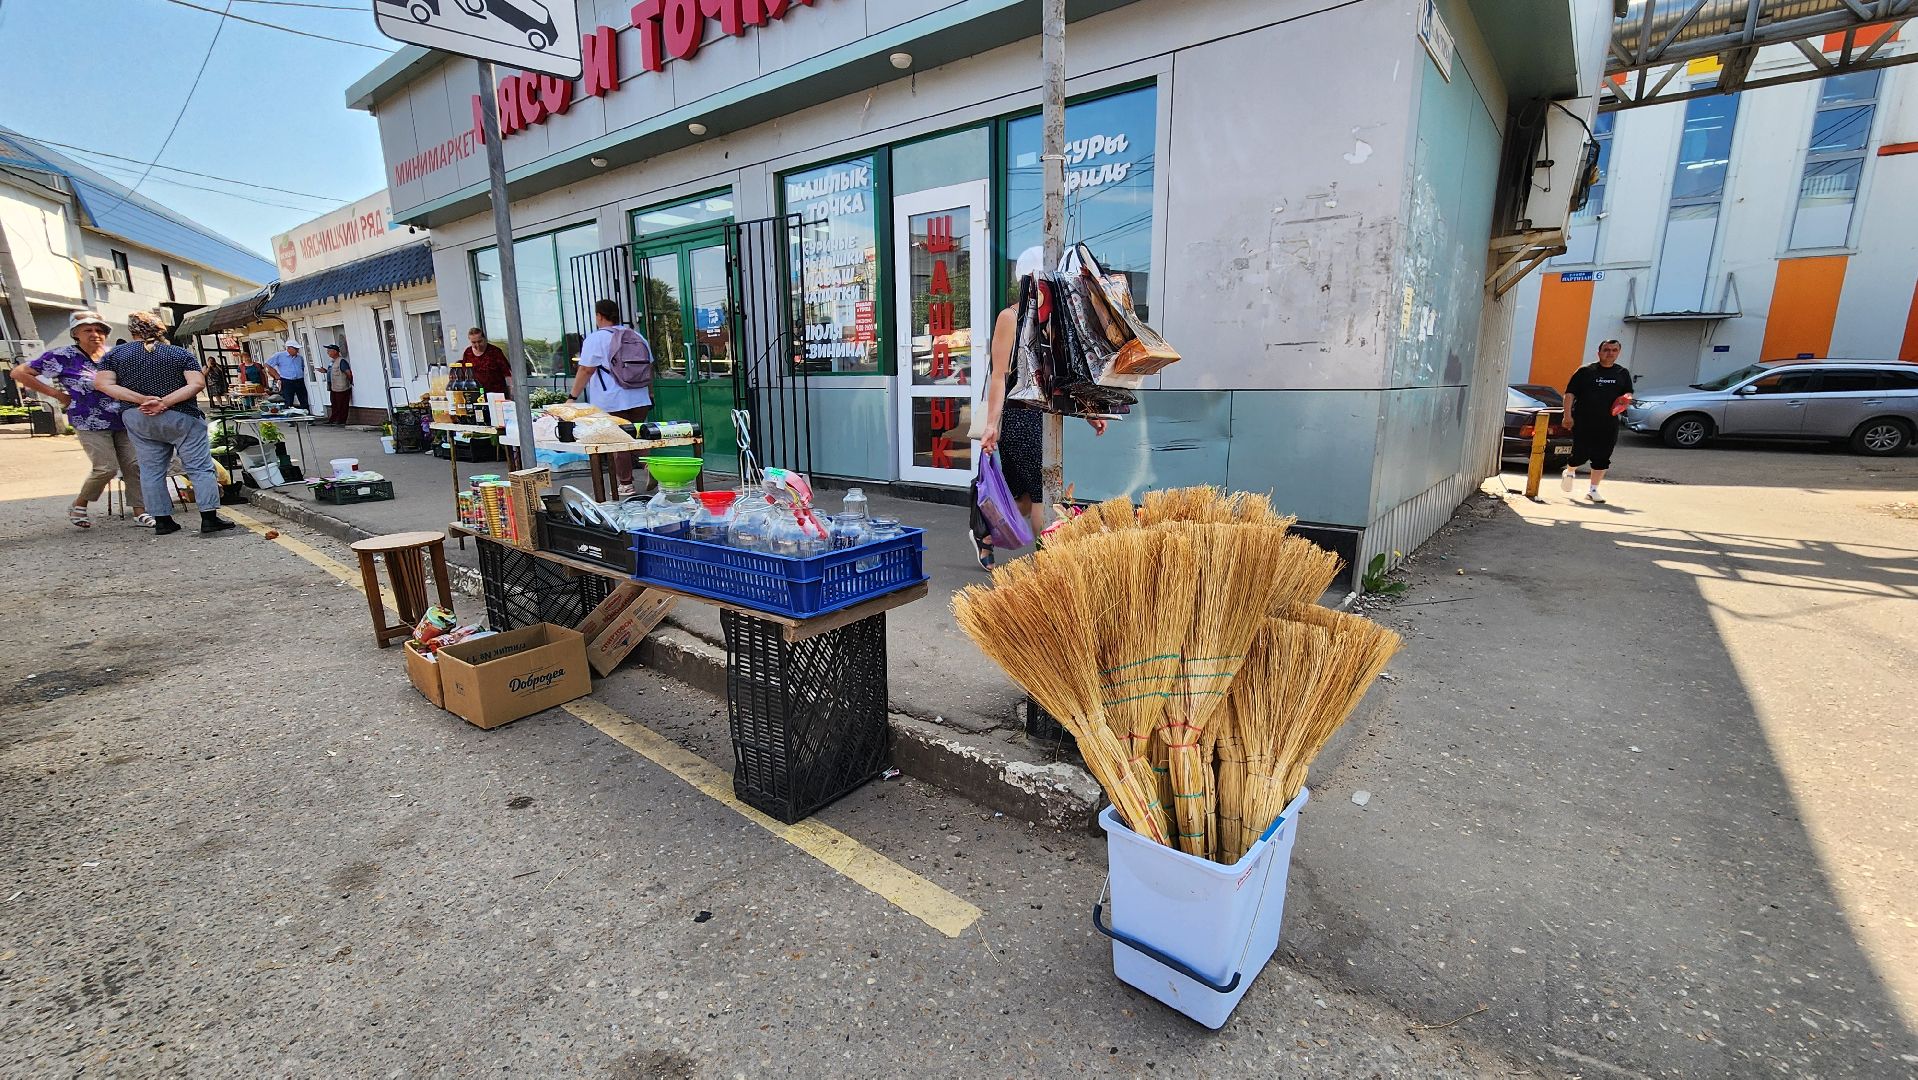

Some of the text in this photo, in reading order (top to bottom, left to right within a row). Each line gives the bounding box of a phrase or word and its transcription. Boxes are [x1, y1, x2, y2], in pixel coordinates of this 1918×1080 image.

[583, 25, 619, 97] И
[395, 129, 477, 187] МИНИМАРКЕТ
[787, 165, 869, 204] ШАШЛЫК
[1064, 162, 1131, 196] риль
[806, 192, 865, 220] ТОЧКА
[300, 208, 385, 259] МЯСНИЦКИЙ РЯД
[508, 668, 566, 693] Добродея
